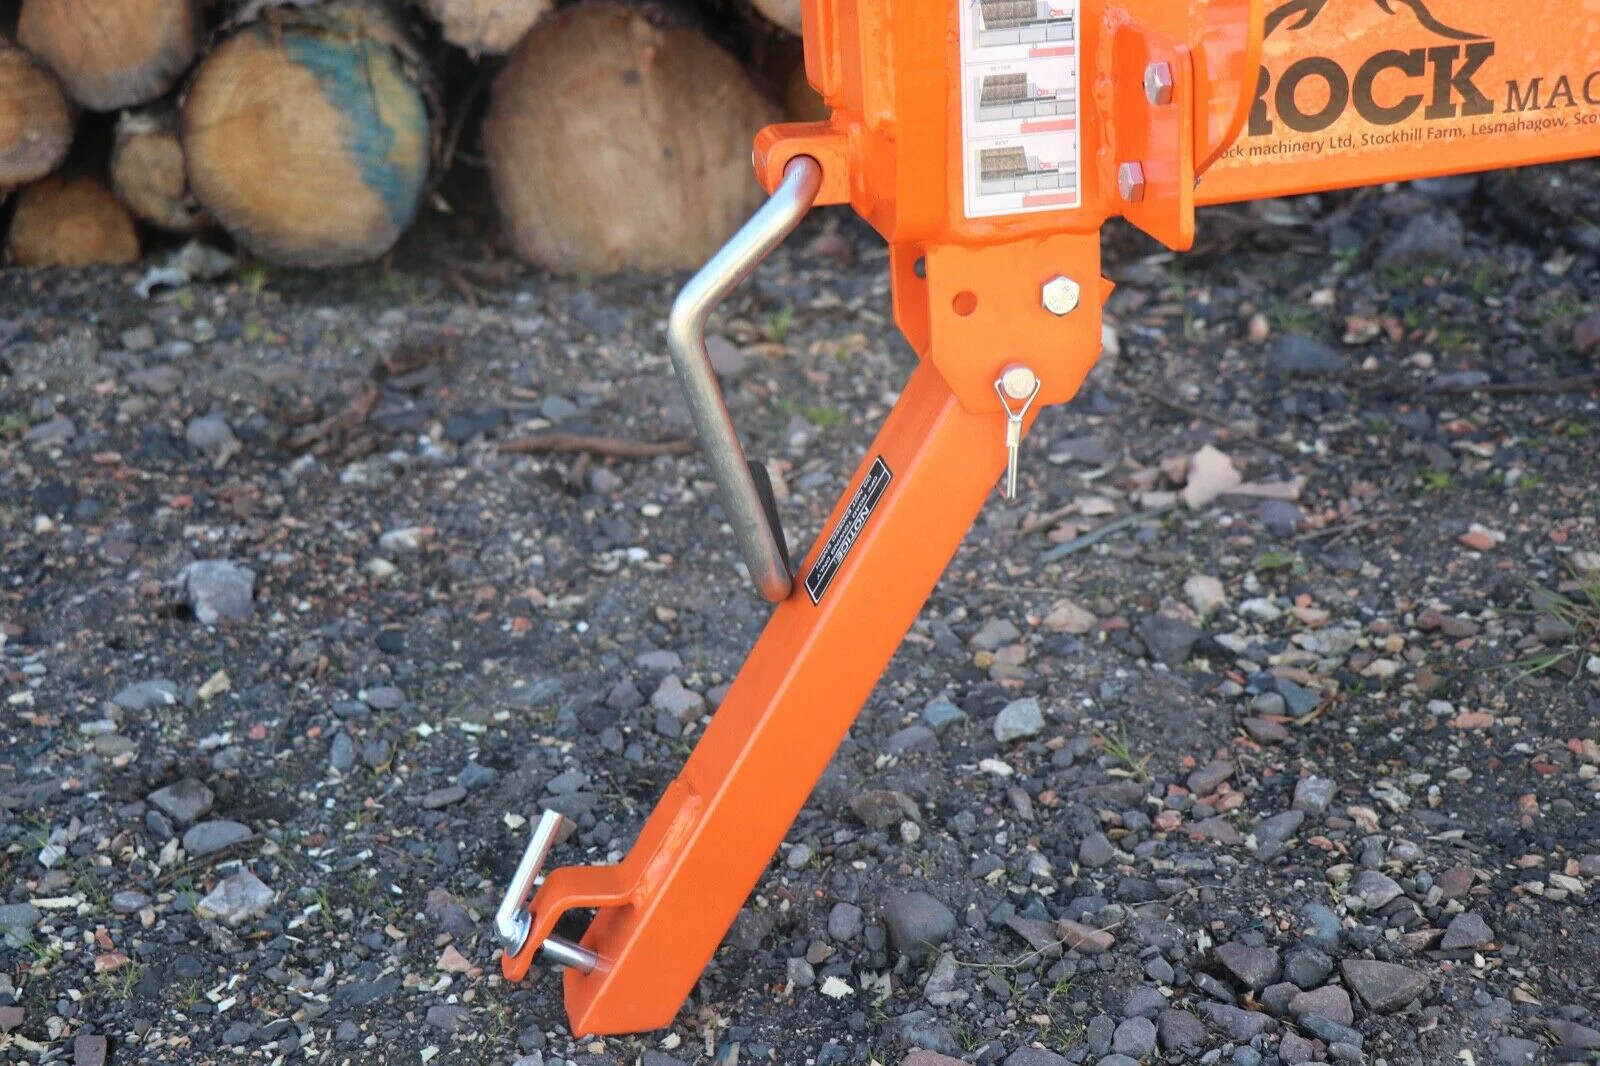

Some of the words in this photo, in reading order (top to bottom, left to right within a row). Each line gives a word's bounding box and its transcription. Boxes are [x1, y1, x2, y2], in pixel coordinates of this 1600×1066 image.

[1220, 145, 1245, 159] ock
[1249, 140, 1325, 156] machinery
[1329, 134, 1356, 149] Ltd,
[1361, 127, 1422, 146] Stockhill
[1427, 126, 1466, 139] Farm,
[1472, 116, 1568, 136] Lesmahagow,
[1573, 112, 1600, 125] Sco
[867, 476, 878, 492] OFF
[851, 494, 867, 519] ROAD
[831, 521, 852, 555] TOWING
[816, 556, 831, 581] ONLY
